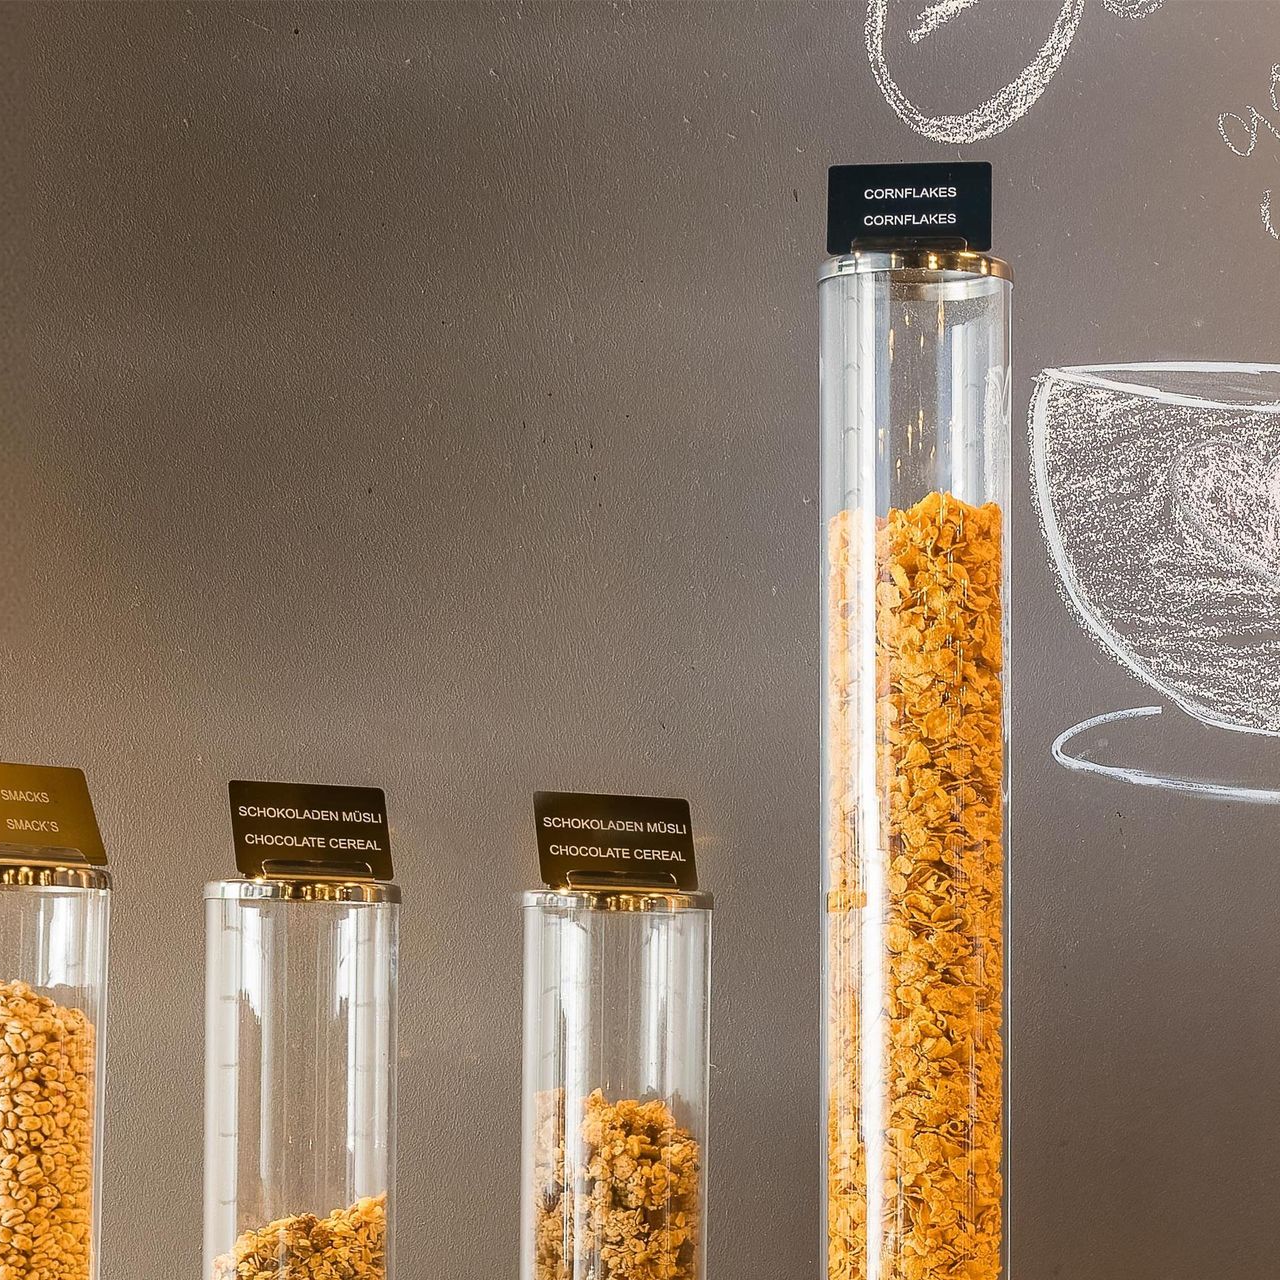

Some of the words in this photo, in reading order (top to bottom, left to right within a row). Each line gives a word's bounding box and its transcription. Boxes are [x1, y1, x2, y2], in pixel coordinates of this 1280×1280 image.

[864, 186, 957, 200] CORNFLAKES
[863, 213, 956, 227] CORNFLAKES
[0, 789, 50, 803] SMACKS
[238, 805, 340, 823] SCHOKOLADEN
[342, 810, 382, 824] MÜSLI
[6, 818, 60, 833] SMACK'S
[543, 816, 644, 834] SCHOKOLADEN
[647, 820, 687, 836] MÜSLI
[244, 833, 326, 849] CHOCOLATE
[328, 836, 382, 851] CEREAL
[549, 844, 631, 860] CHOCOLATE
[633, 847, 687, 862] CEREAL
